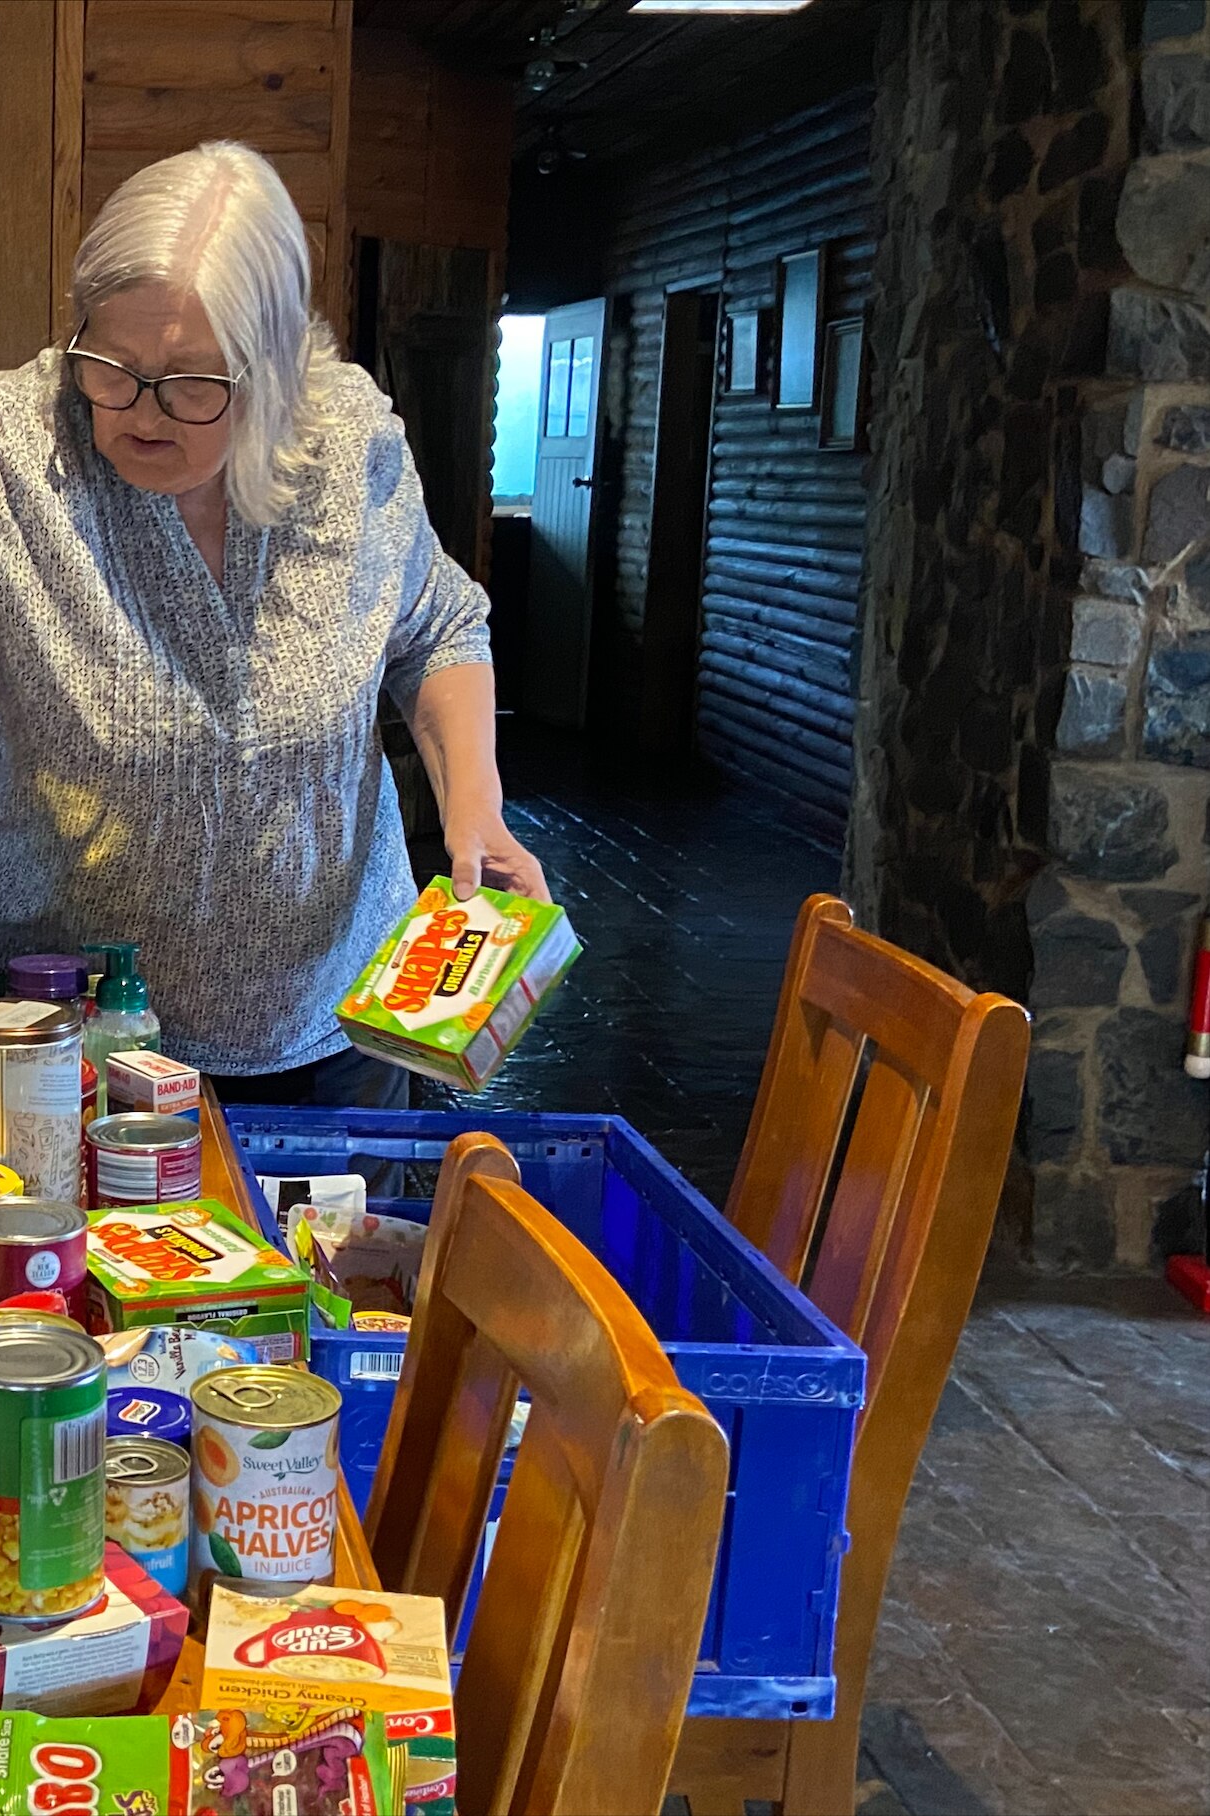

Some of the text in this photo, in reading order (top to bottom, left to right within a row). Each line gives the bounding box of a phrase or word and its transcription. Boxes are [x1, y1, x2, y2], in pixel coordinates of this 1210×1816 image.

[442, 932, 483, 993] ORIGINALS
[157, 1077, 198, 1096] BAND-AID
[155, 1227, 217, 1260] ORIGINALS
[168, 1343, 187, 1381] Vanilla
[242, 1454, 322, 1475] Sweet Valley
[259, 1486, 312, 1500] AUSTRALIAN
[214, 1488, 337, 1531] APRICOT
[223, 1521, 330, 1559] HALVES
[254, 1557, 313, 1577] IN JUICE
[276, 1680, 296, 1689] Lots
[298, 1682, 321, 1691] with
[218, 1684, 367, 1707] Creamy Chicken
[0, 1718, 13, 1737] Size
